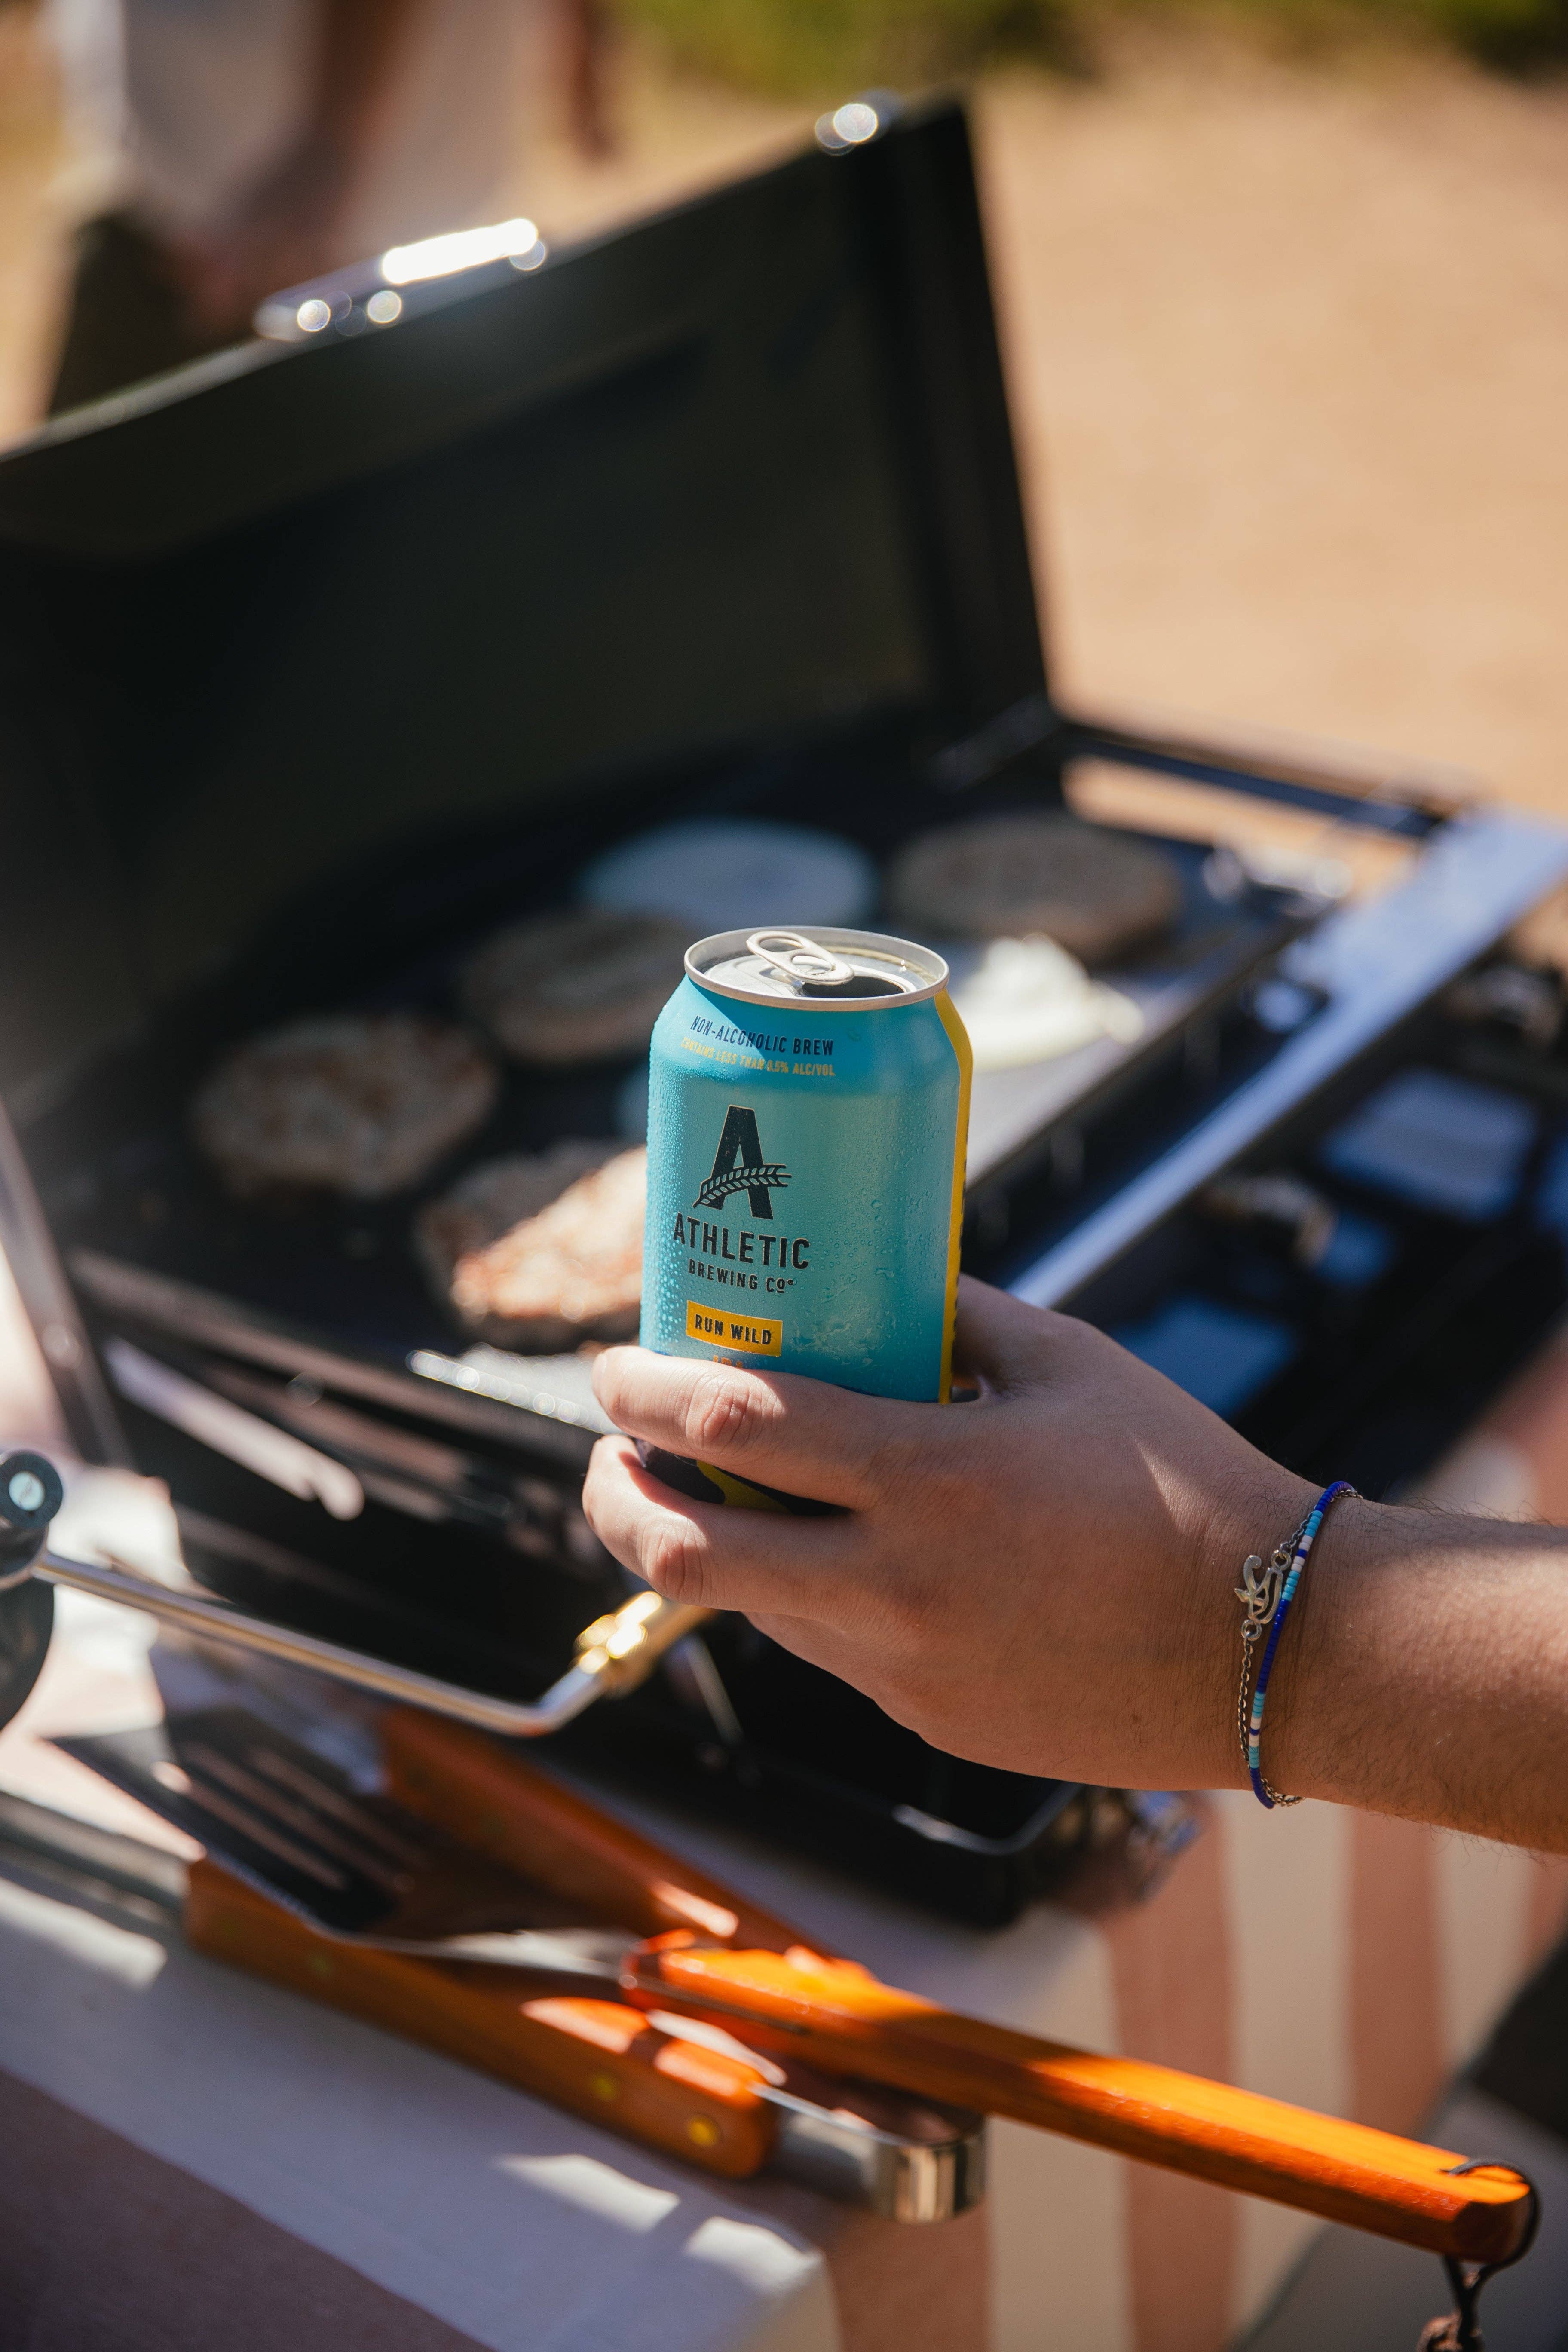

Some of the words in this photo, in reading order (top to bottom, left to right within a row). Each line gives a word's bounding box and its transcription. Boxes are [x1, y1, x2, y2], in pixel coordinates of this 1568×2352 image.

[690, 1015, 787, 1053] NON-ALCOHOLIC
[792, 1038, 834, 1056] BREW
[681, 1036, 715, 1059] CONTAINS
[716, 1049, 737, 1065] LESS
[740, 1055, 765, 1070] THAN
[767, 1059, 789, 1073] 0.5%
[792, 1063, 835, 1076] ALC/VOL
[673, 1211, 810, 1270] ATHLETIC
[689, 1258, 758, 1290] BREWING
[695, 1314, 724, 1336] RUN
[731, 1323, 772, 1345] WILD
